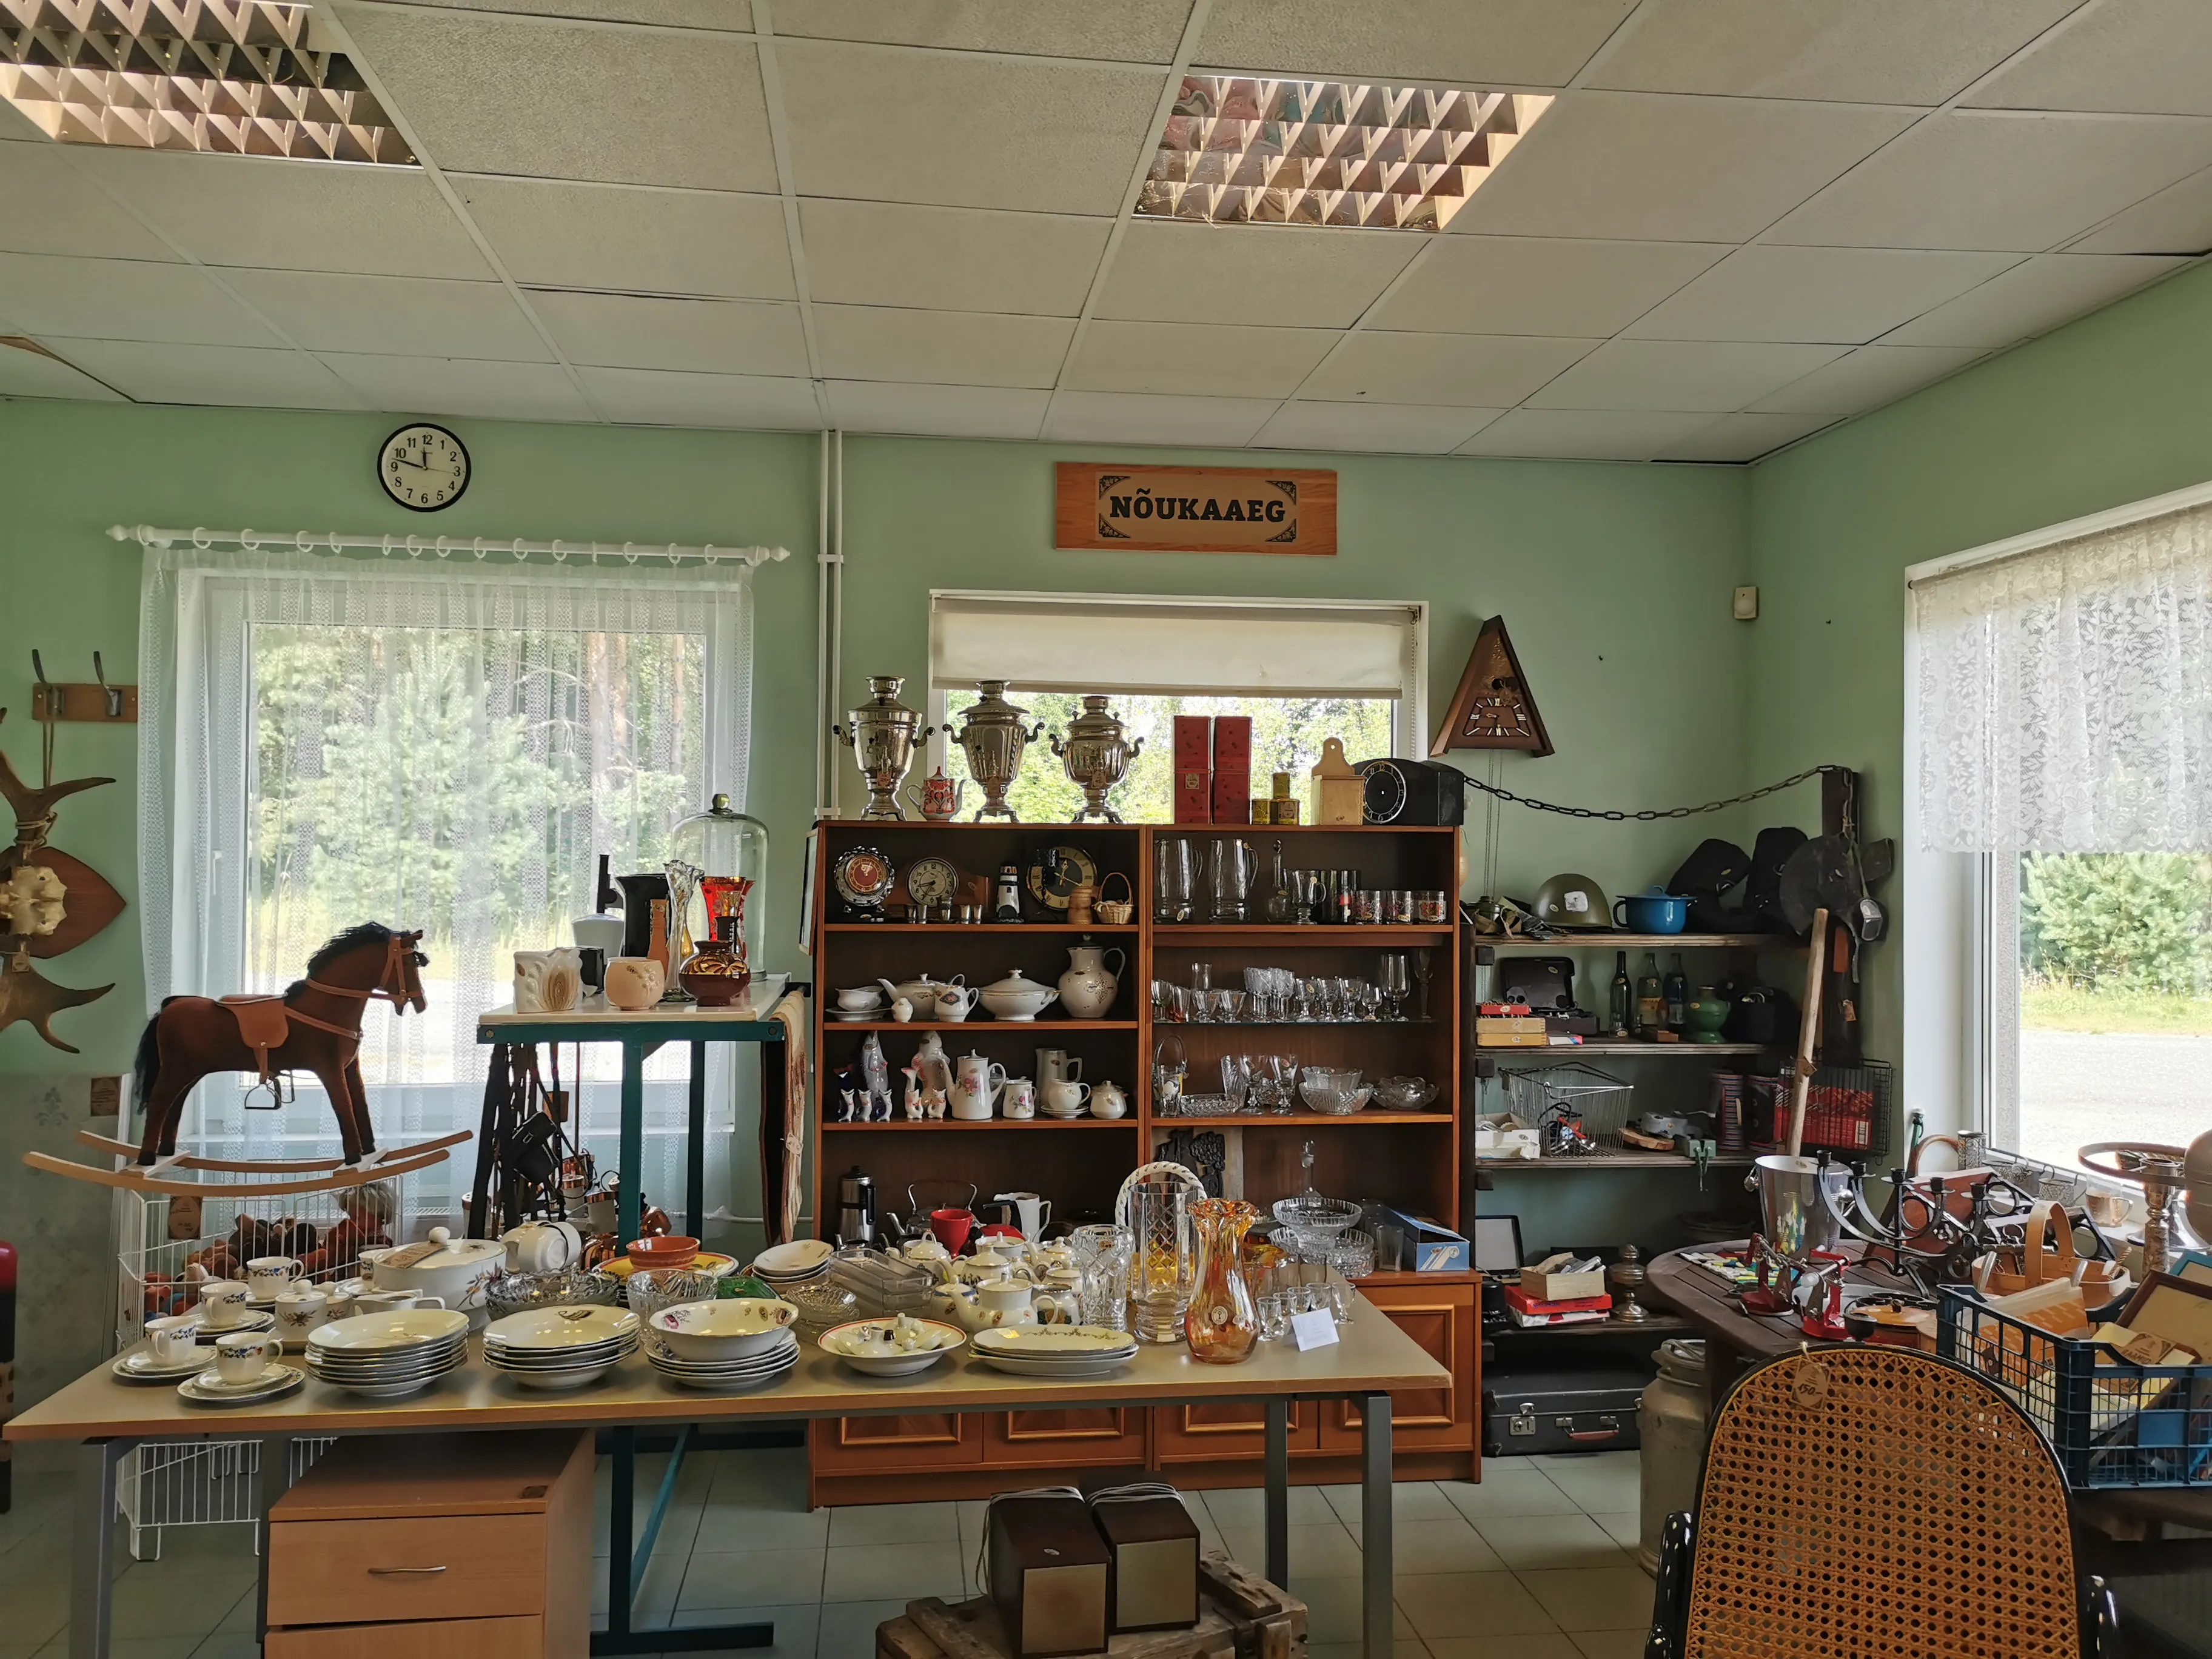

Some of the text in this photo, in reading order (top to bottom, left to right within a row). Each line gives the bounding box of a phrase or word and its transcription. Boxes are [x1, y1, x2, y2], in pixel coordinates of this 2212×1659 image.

[407, 438, 416, 447] 11
[422, 435, 433, 445] 12
[440, 440, 444, 450] 1
[395, 448, 406, 458] 10
[450, 451, 457, 461] 2
[390, 462, 398, 472] 9
[454, 466, 461, 477] 3
[395, 477, 402, 487] 8
[448, 481, 455, 491] 4
[406, 489, 413, 498] 7
[421, 493, 428, 503] 6
[437, 491, 443, 501] 5
[1110, 488, 1286, 523] NÕUKAAEG
